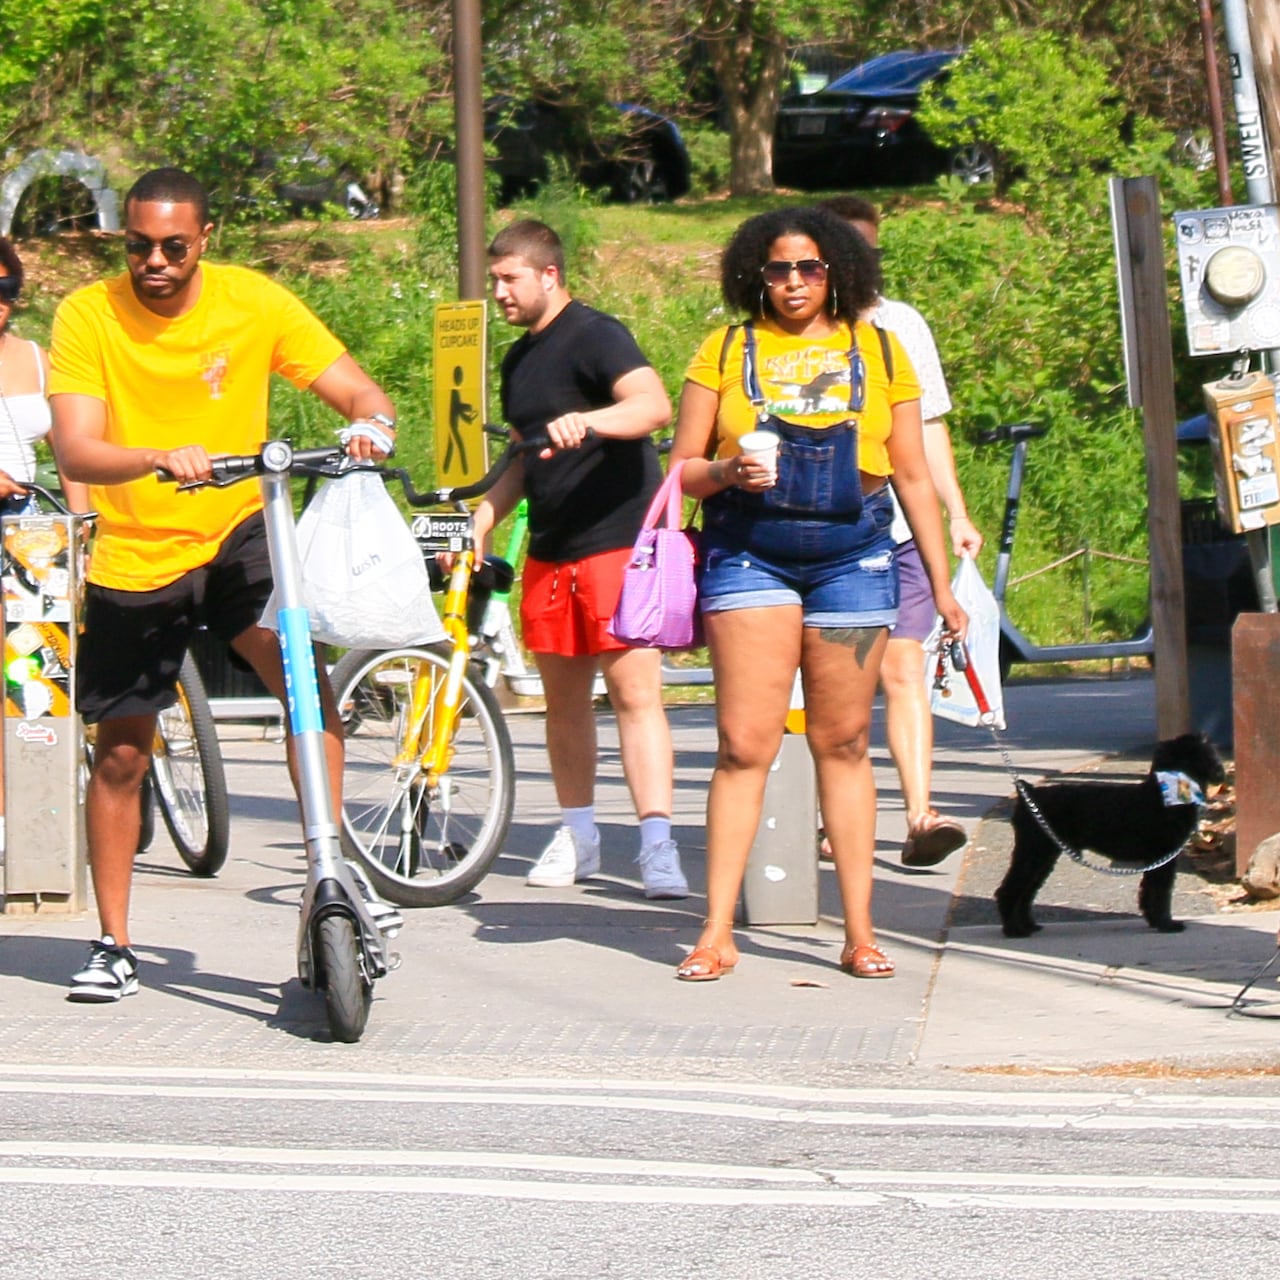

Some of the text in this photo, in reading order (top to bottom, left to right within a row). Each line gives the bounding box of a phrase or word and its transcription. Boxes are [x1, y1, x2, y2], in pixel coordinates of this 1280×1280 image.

[439, 317, 480, 333] HEADS UP
[439, 333, 479, 349] CUPCAKE
[432, 521, 467, 532] ROOTS
